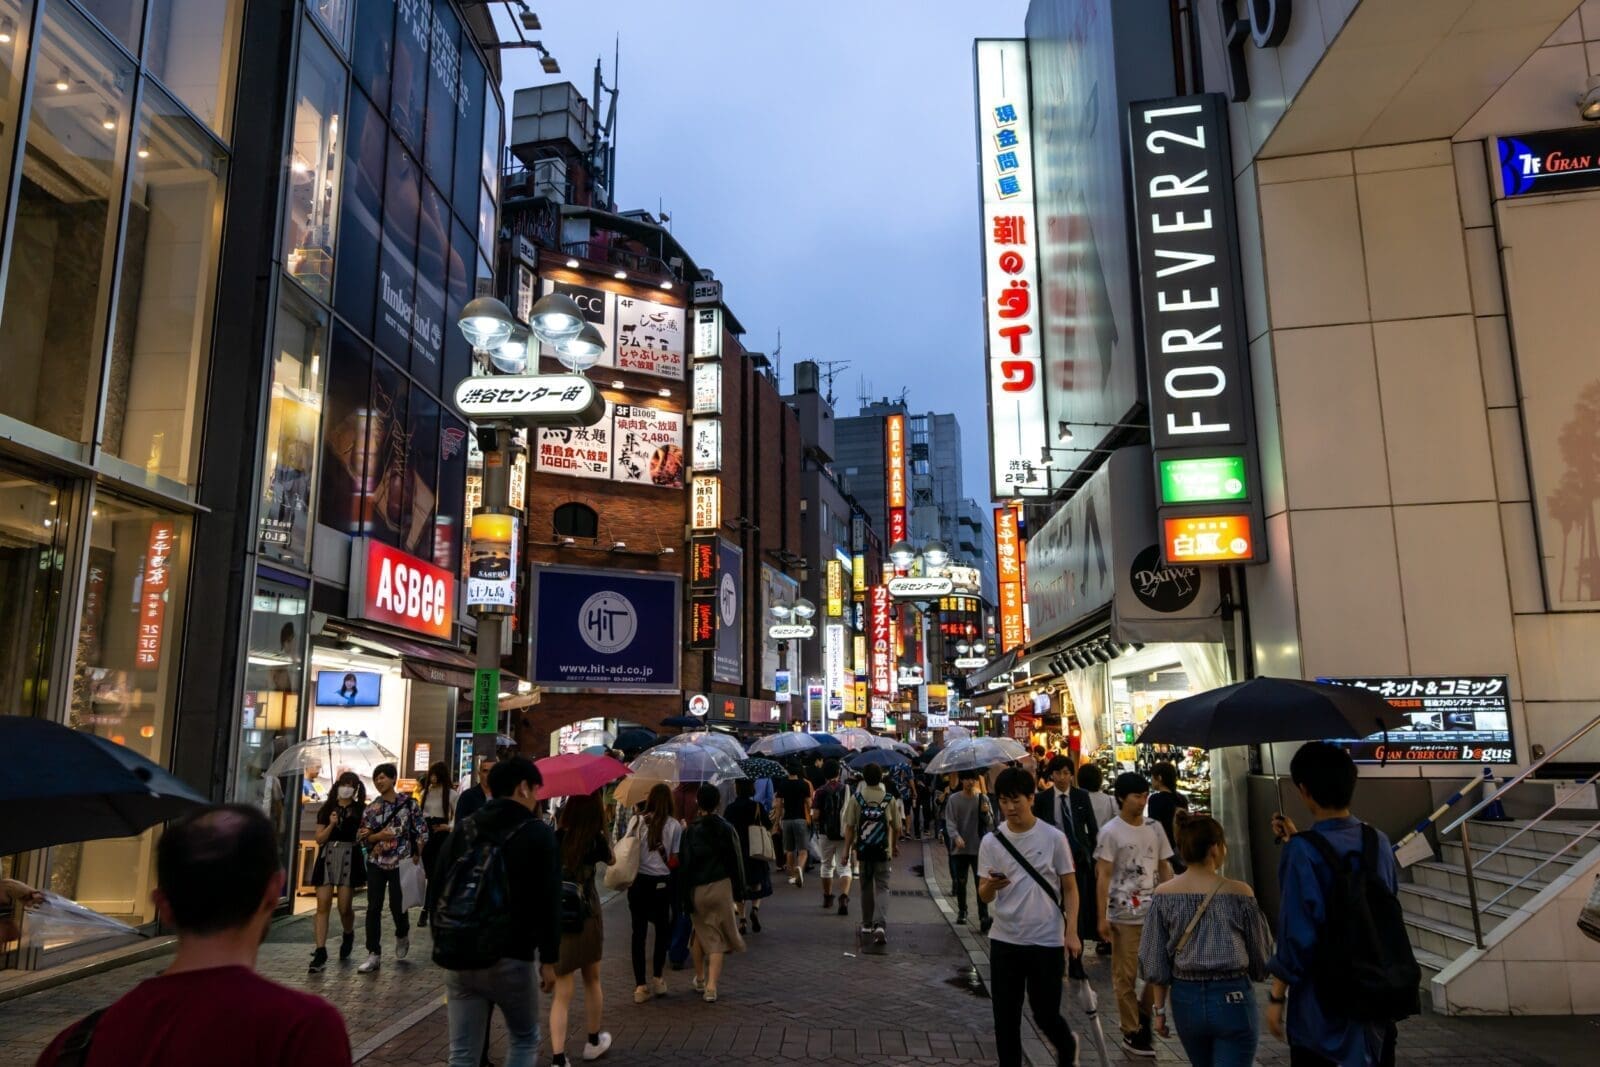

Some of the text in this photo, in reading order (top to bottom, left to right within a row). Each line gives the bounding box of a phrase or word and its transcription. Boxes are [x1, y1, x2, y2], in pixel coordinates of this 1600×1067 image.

[412, 19, 428, 53] NO
[1144, 104, 1205, 154] 21
[1519, 151, 1591, 175] 7F GRAN
[621, 299, 634, 308] 4F
[1150, 169, 1231, 435] FOREVER
[619, 335, 641, 347] ラム
[619, 347, 681, 364] しゃぶしゃぶ
[620, 358, 654, 371] 食べ放題
[461, 386, 584, 404] 渋谷センター街
[616, 405, 629, 415] 3F
[617, 420, 678, 432] 焼肉食べ放題
[540, 443, 608, 462] 焼鳥食べ放題
[1009, 460, 1031, 471] 渋谷
[1004, 474, 1028, 483] 2号
[375, 557, 446, 626] ASBee
[1005, 616, 1019, 625] 2F
[1006, 630, 1020, 639] 3F
[559, 664, 654, 677] www.hit-ad.co.jp
[1406, 751, 1434, 760] CYBER
